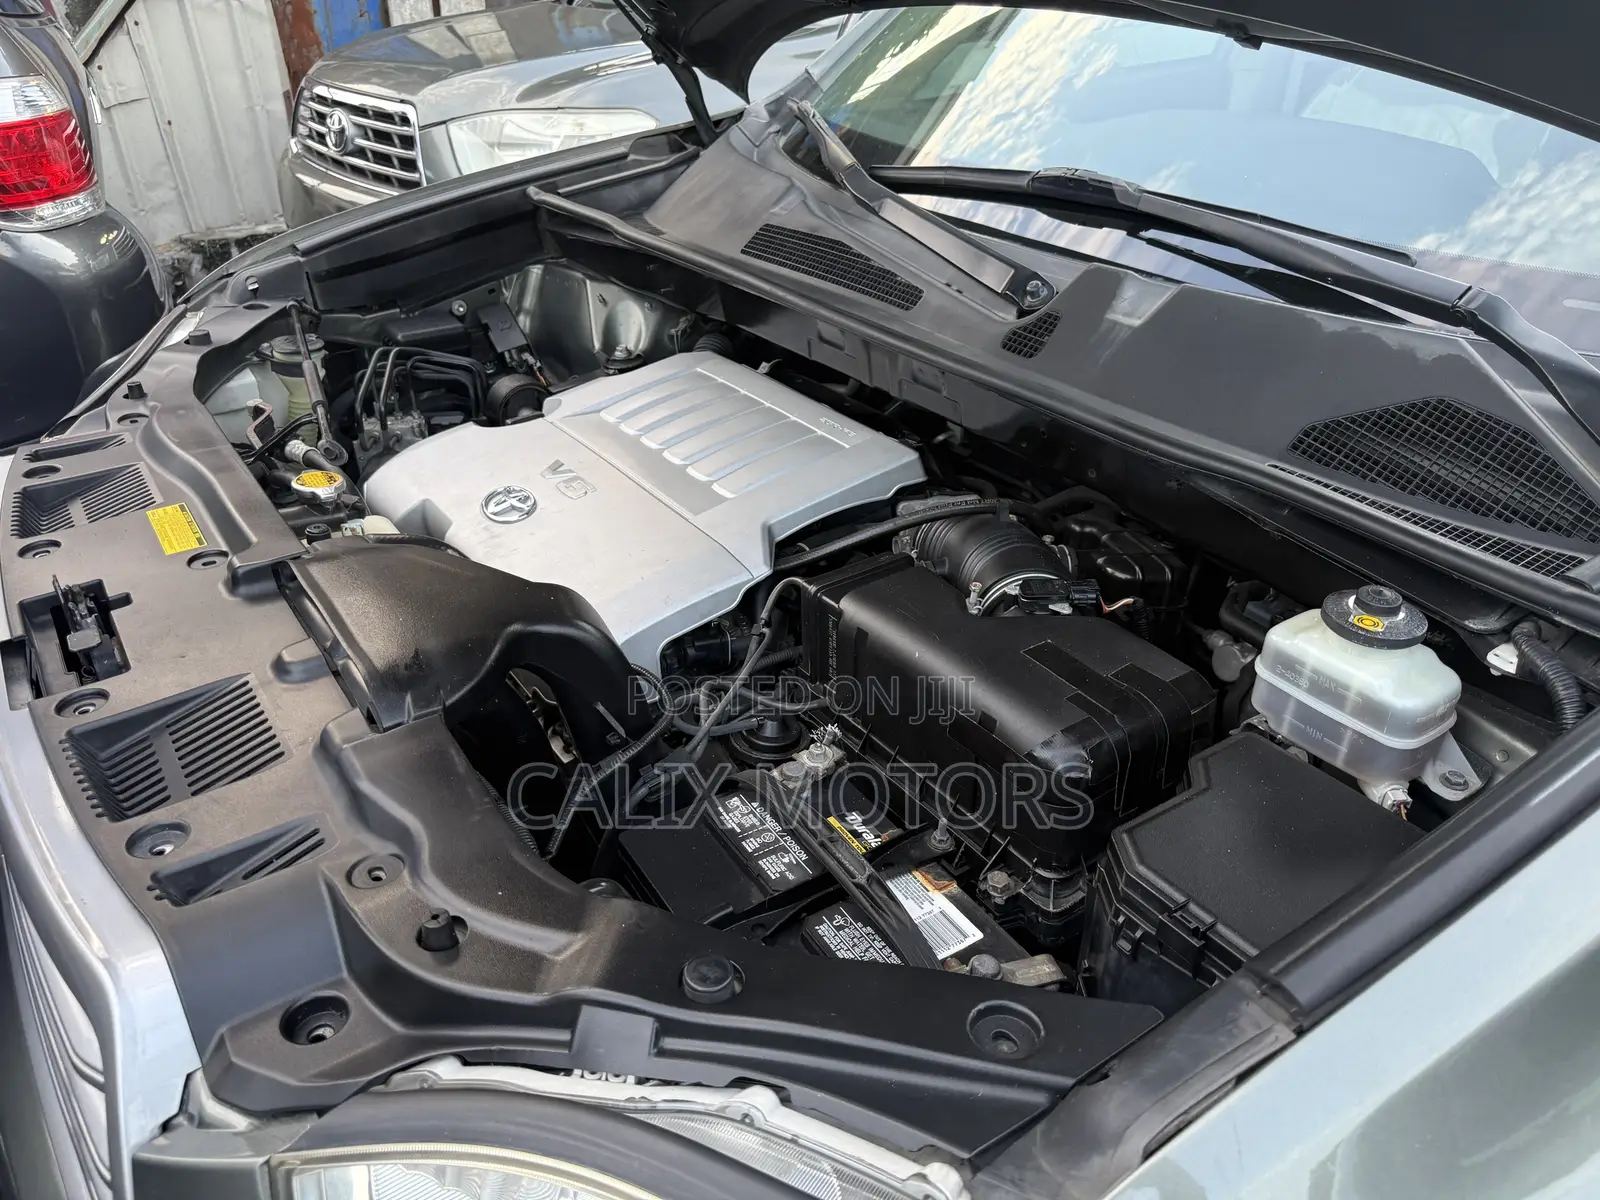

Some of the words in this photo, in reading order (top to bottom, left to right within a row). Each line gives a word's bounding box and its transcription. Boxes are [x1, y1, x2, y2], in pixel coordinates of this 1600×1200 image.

[540, 458, 597, 500] V6
[1318, 676, 1337, 692] MAX
[1305, 724, 1324, 741] MIN
[755, 806, 783, 832] DANGER
[781, 835, 809, 861] POISON
[845, 811, 882, 848] Durala
